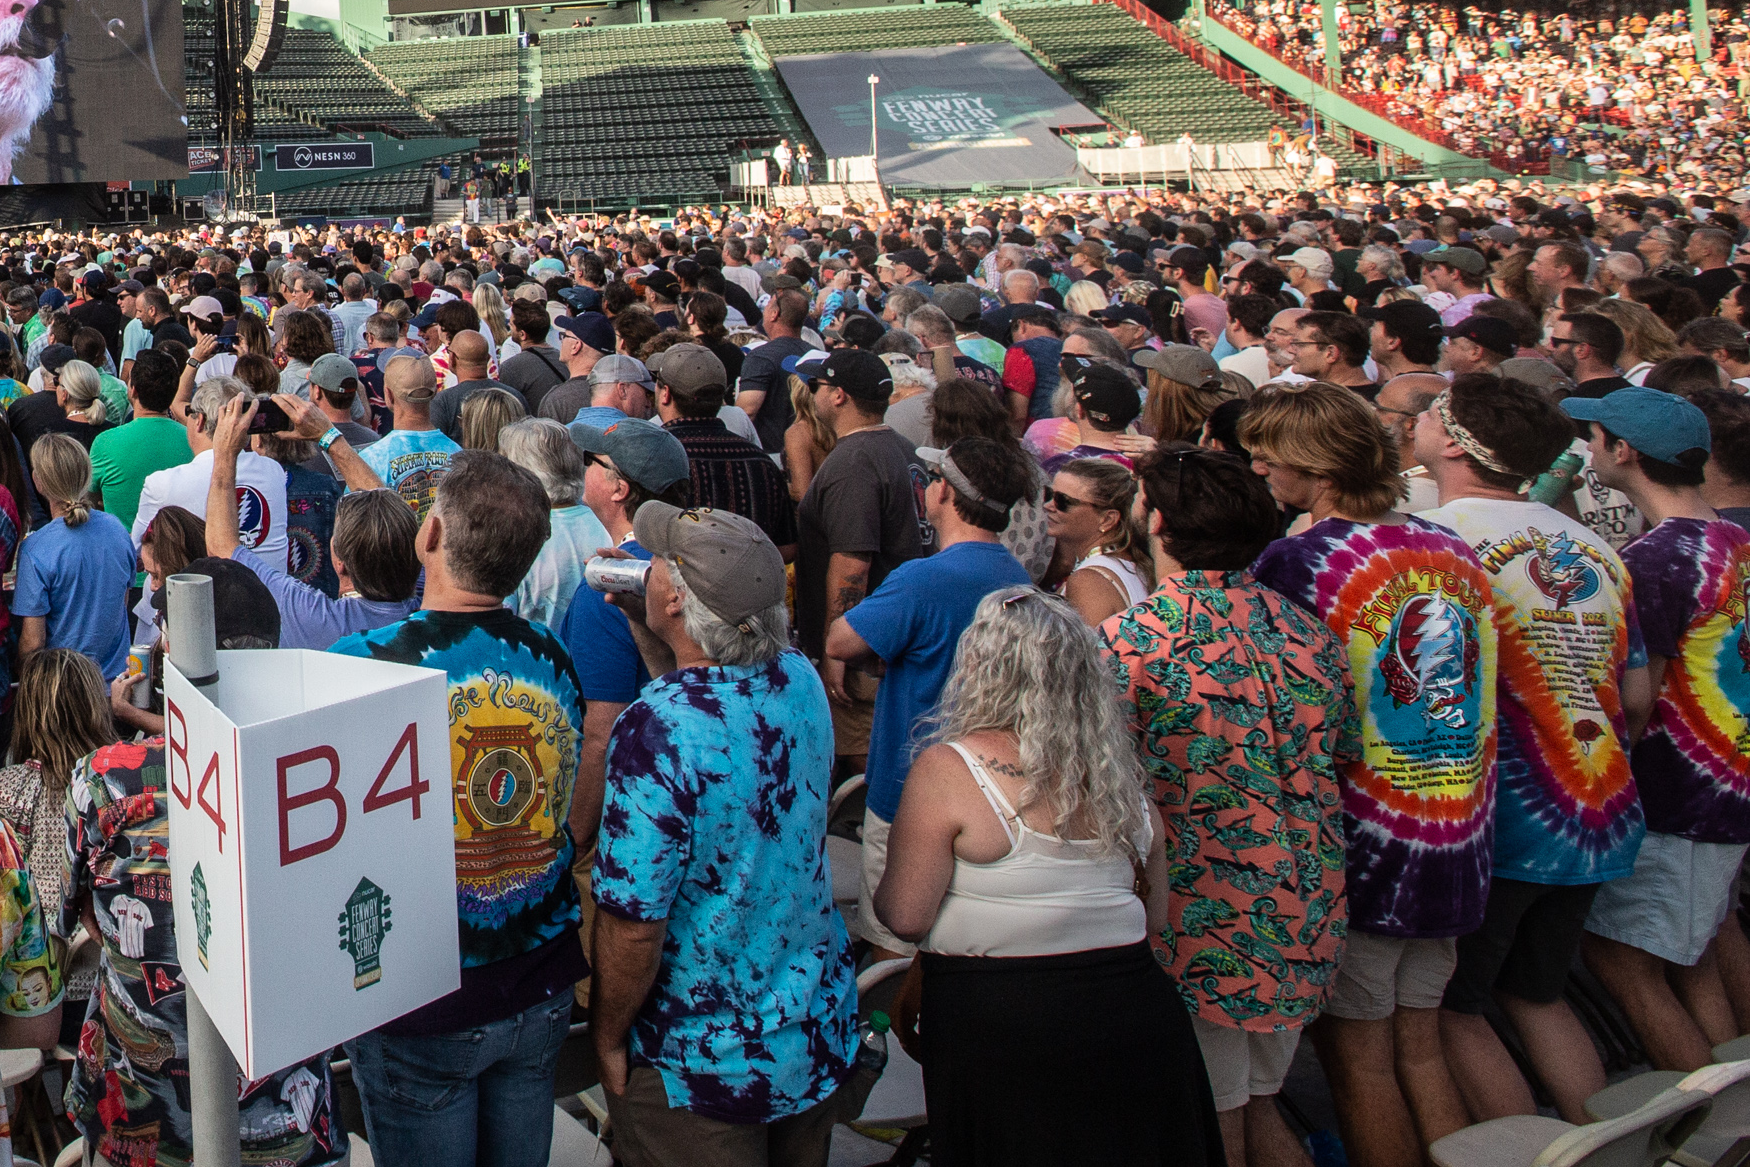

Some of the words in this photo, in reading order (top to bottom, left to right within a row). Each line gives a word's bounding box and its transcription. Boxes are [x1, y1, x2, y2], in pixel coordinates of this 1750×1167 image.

[882, 97, 988, 115] FENWAY
[888, 108, 998, 122] CONCERT
[908, 118, 1000, 133] SERIES
[190, 150, 212, 160] ACE
[191, 158, 212, 167] TICKET
[314, 152, 341, 161] NESN
[342, 151, 356, 160] 360
[389, 452, 424, 480] SUMMER
[1479, 530, 1534, 575] FINAL
[1351, 569, 1419, 648] FINAL
[1417, 566, 1486, 625] TOUR
[168, 696, 227, 855] B4
[276, 721, 430, 868] B4
[134, 884, 157, 899] RED
[158, 888, 173, 902] SO
[351, 897, 379, 924] FENWAY
[352, 915, 379, 943] CONCERT
[355, 935, 378, 960] SERIES
